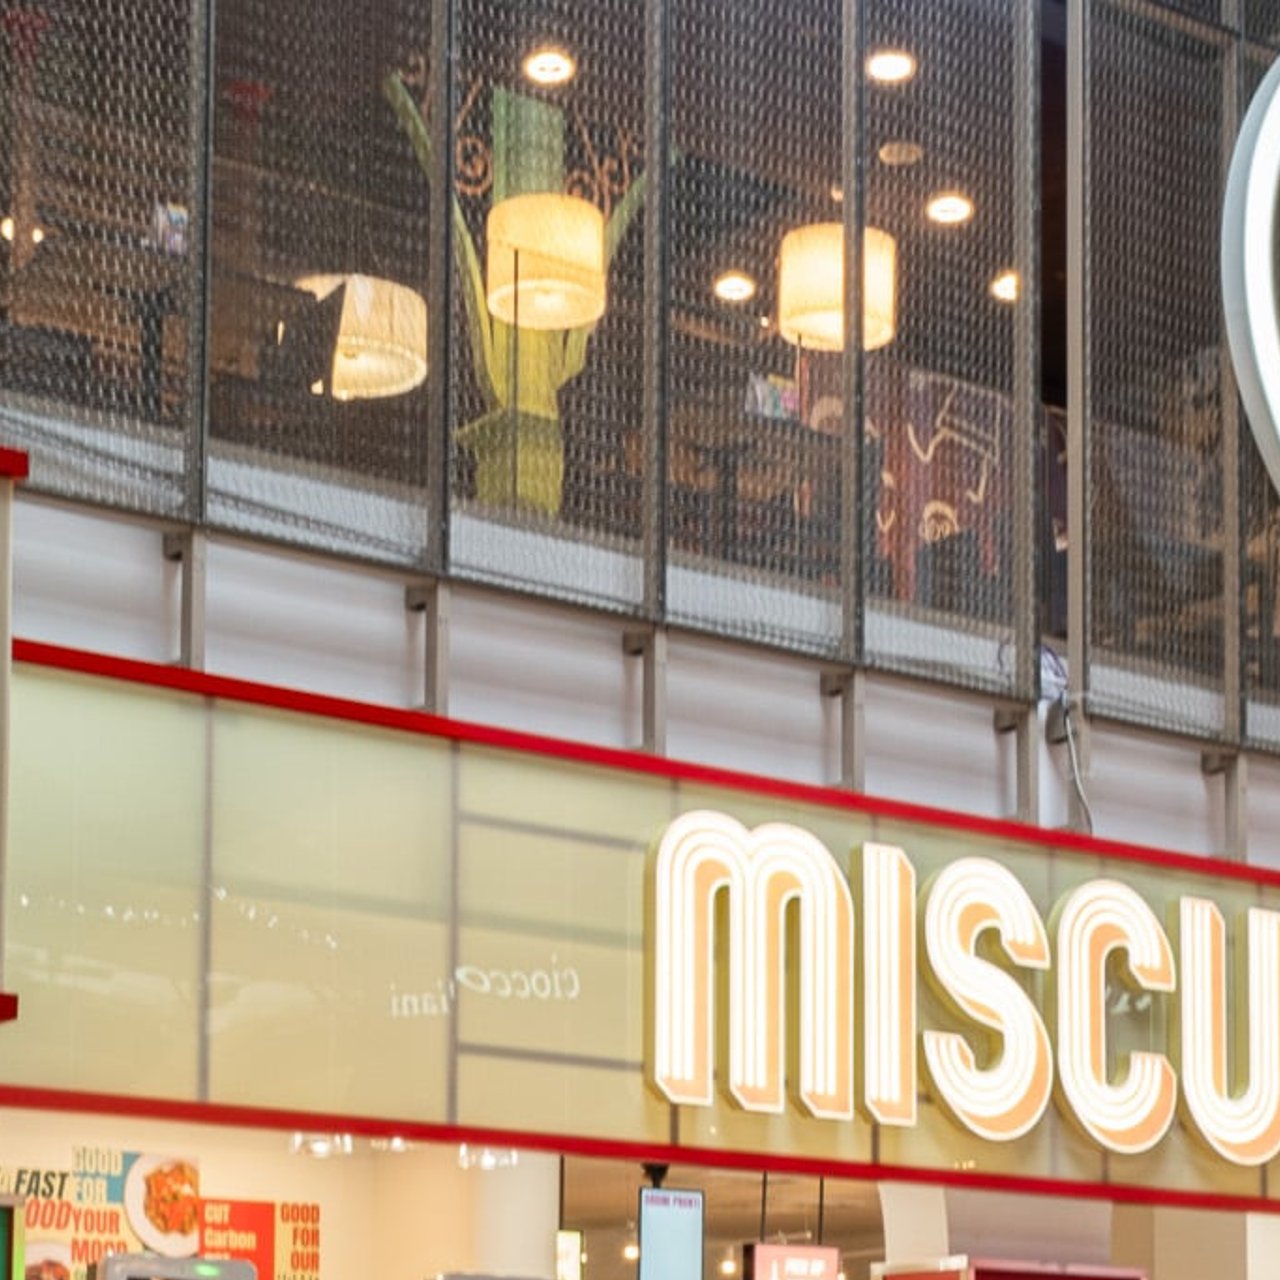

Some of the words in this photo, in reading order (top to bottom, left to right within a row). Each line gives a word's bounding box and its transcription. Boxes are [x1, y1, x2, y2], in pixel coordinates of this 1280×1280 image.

[13, 1169, 70, 1199] FAST
[24, 1200, 71, 1229] OOD
[72, 1207, 120, 1235] YOUR
[280, 1202, 320, 1224] GOOD
[203, 1227, 257, 1250] Carbon
[292, 1223, 320, 1247] FOR
[290, 1250, 320, 1272] OUR
